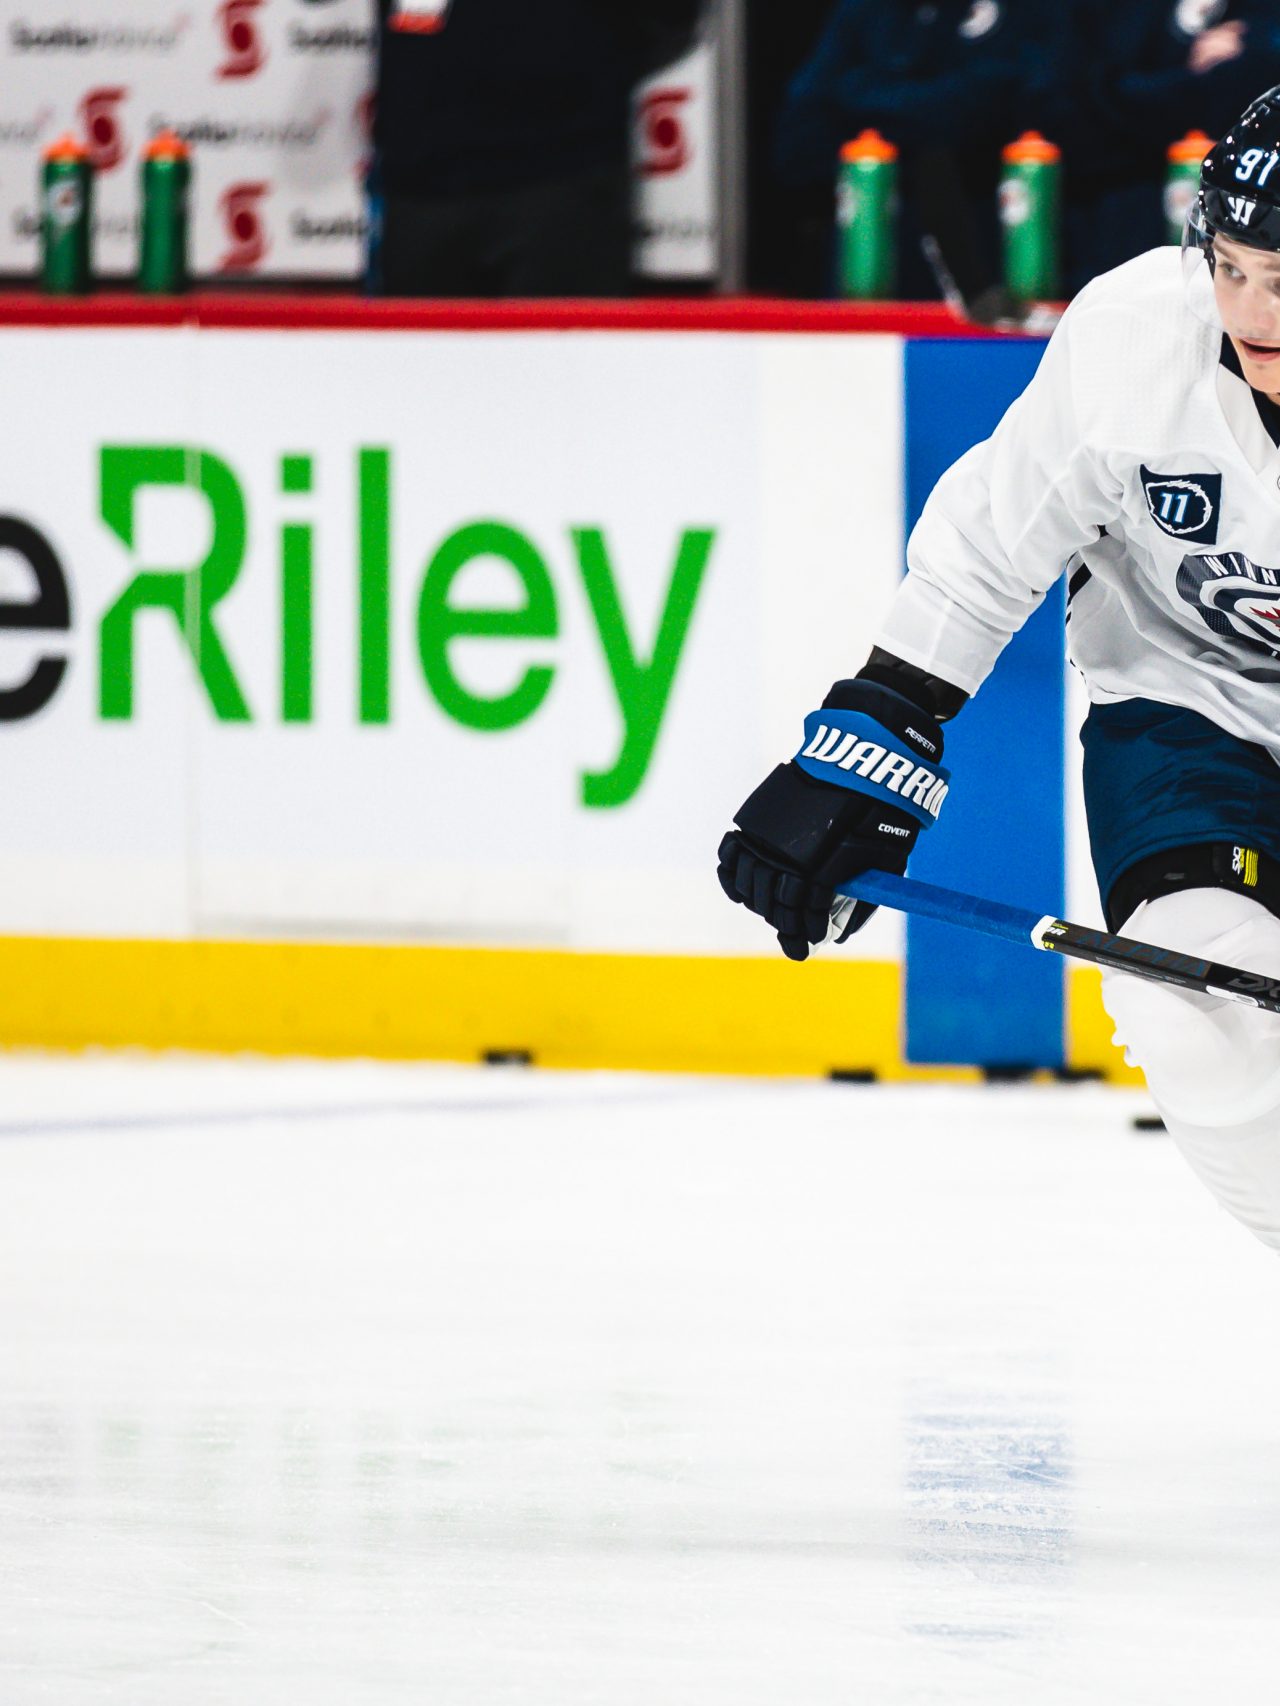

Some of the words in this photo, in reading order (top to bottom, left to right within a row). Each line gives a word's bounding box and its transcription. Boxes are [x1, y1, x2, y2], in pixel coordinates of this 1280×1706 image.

[1235, 148, 1280, 186] 91
[1159, 493, 1190, 524] 11
[878, 823, 911, 839] COVERT
